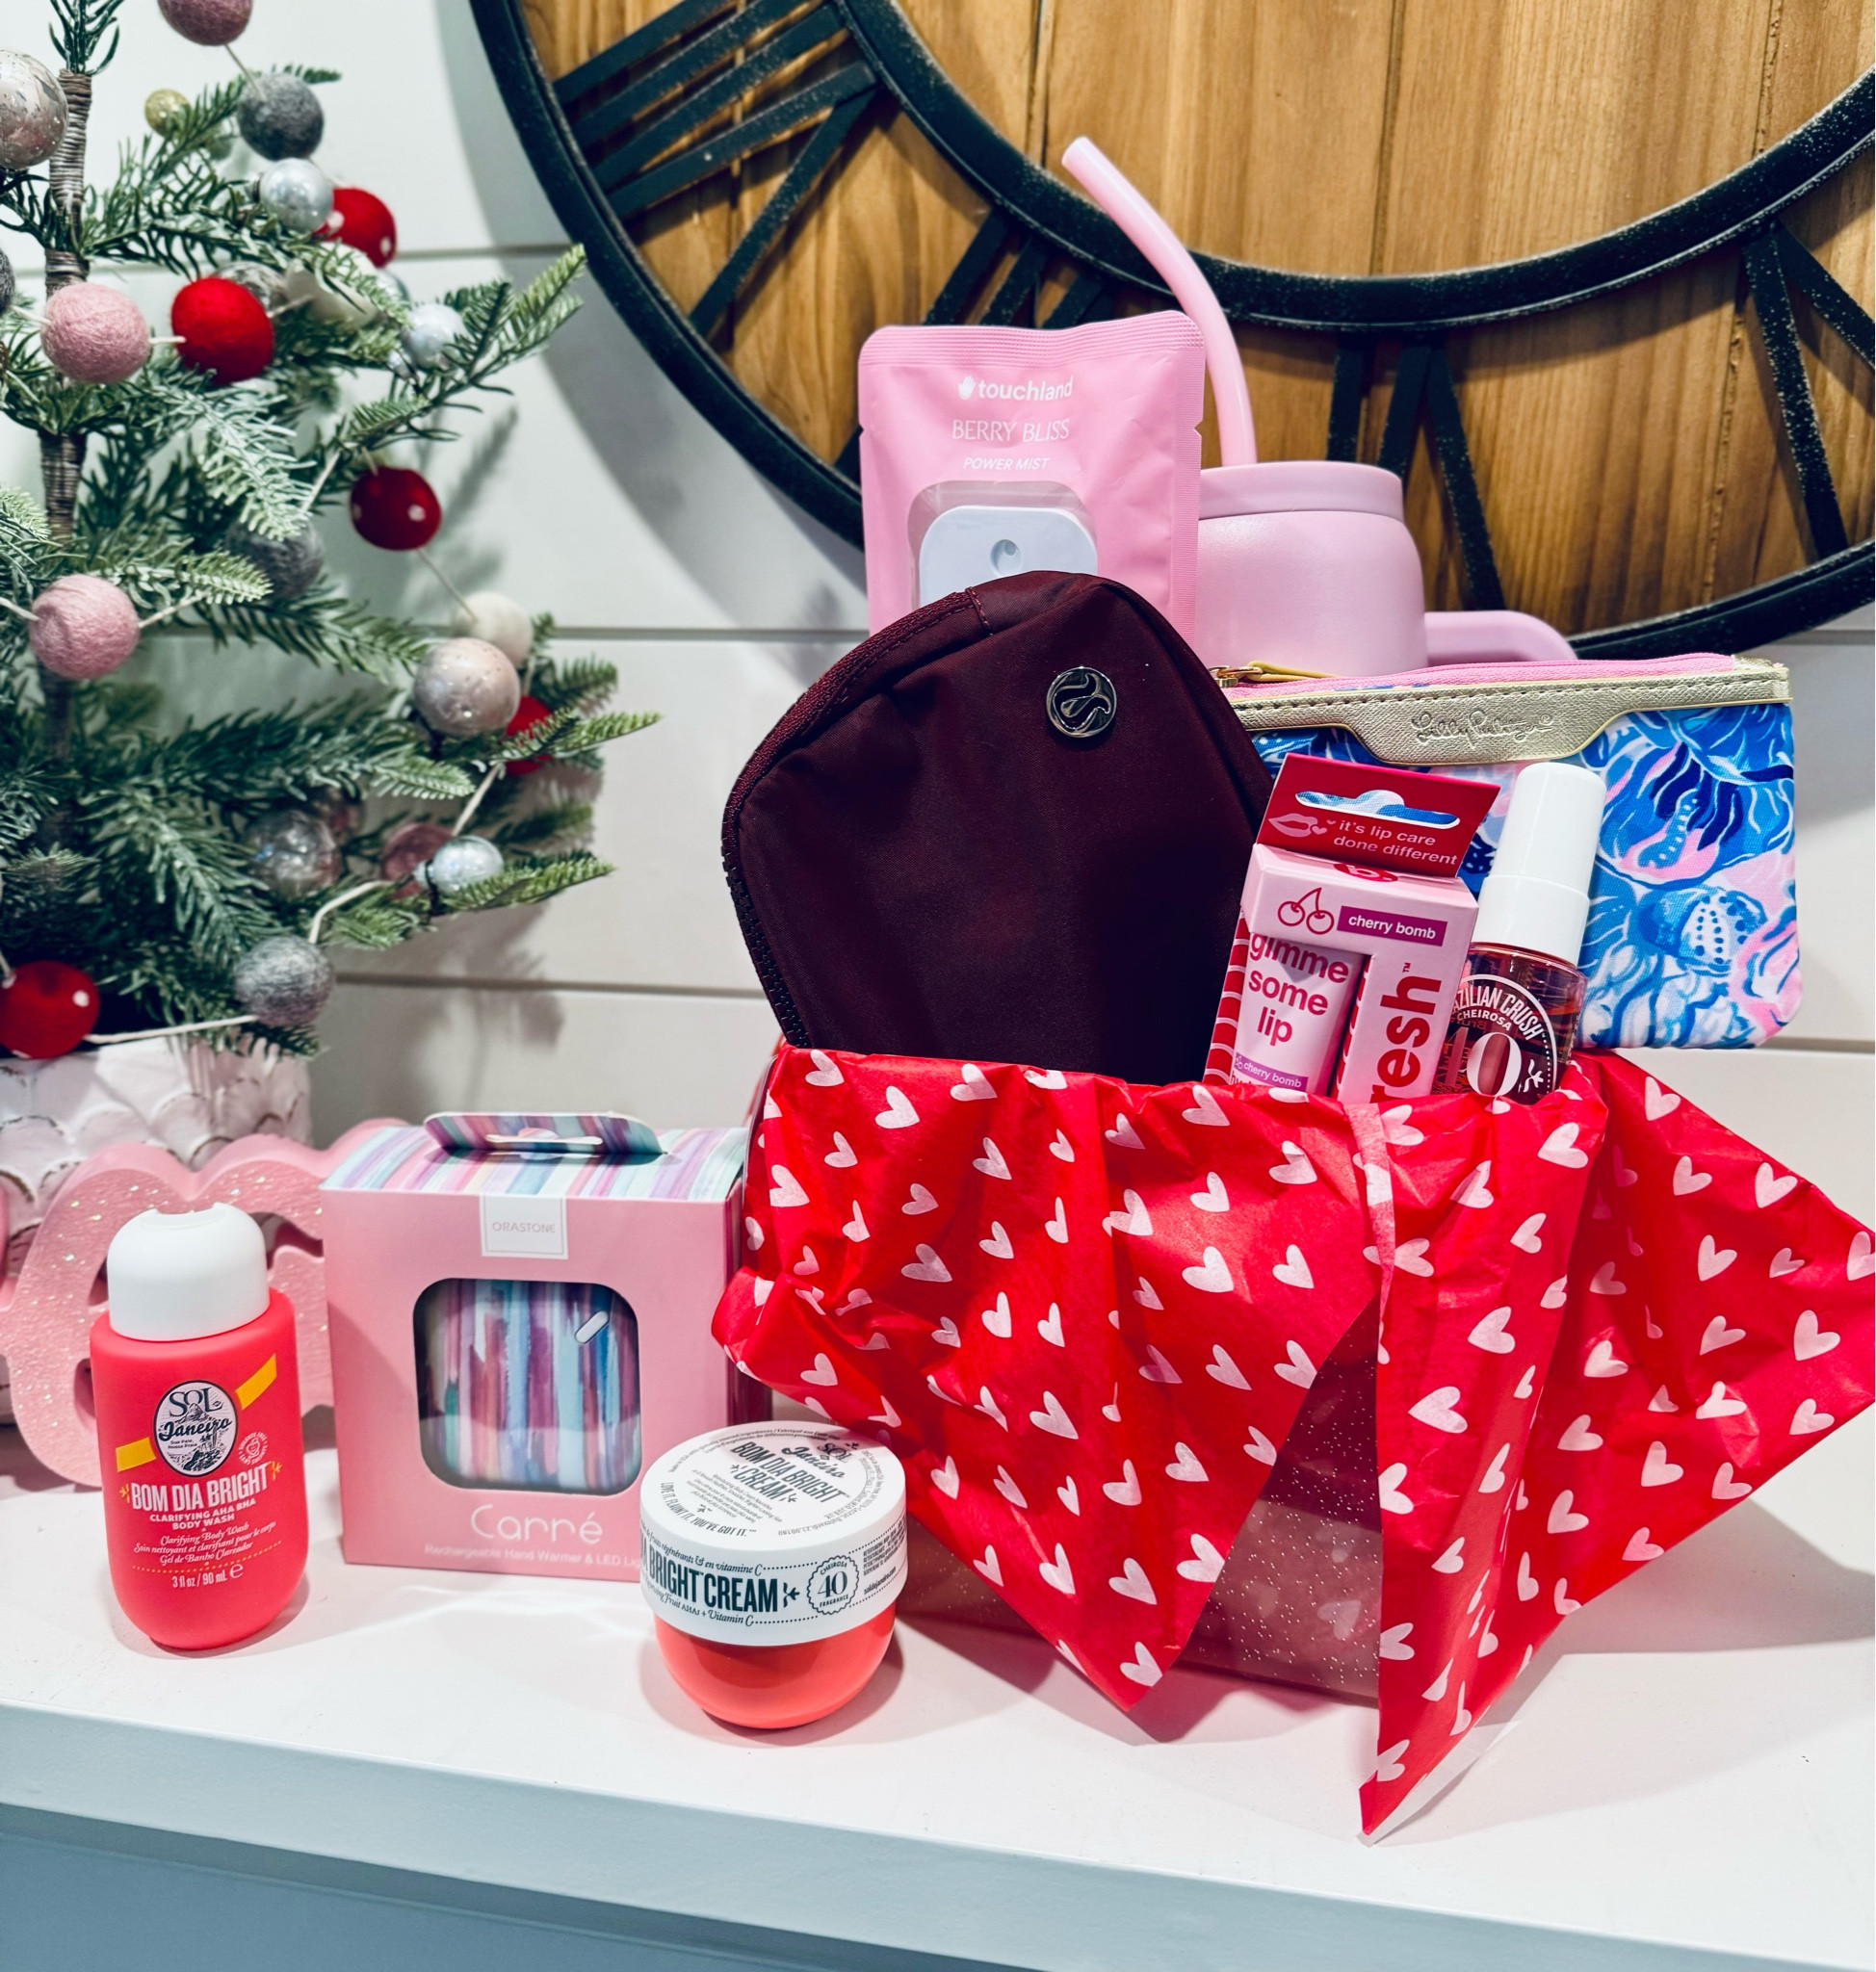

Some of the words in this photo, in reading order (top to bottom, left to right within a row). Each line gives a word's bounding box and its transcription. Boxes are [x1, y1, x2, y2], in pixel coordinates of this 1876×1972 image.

[978, 376, 1074, 401] touchland
[952, 420, 1016, 441] BERRY
[1022, 419, 1070, 442] BLISS
[964, 457, 1013, 471] POWER
[1015, 457, 1052, 470] MIST
[1339, 819, 1365, 834] it's
[1369, 825, 1393, 841] lip
[1396, 832, 1436, 846] care
[1334, 836, 1378, 852] done
[1383, 845, 1458, 866] different
[1348, 915, 1393, 935] cherry
[1396, 922, 1436, 940] bomb
[1249, 933, 1349, 983] gimme
[1248, 970, 1329, 1016] some
[1453, 985, 1502, 1014] AZILIAN
[1499, 994, 1544, 1041] CRUSH
[1457, 1009, 1512, 1031] CHEIROSA
[1257, 1006, 1292, 1047] lip
[1243, 1062, 1271, 1080] cherry
[1272, 1072, 1302, 1088] bomb
[492, 1222, 556, 1233] ORASTONE
[169, 1387, 223, 1417] SOL
[158, 1417, 233, 1442] Janeiro
[730, 1441, 769, 1465] BOM
[762, 1453, 796, 1476] DIA
[781, 1469, 847, 1502] BRIGHT
[781, 1446, 846, 1478] Janeiro
[131, 1482, 169, 1512] BOM
[171, 1482, 204, 1512] DIA
[206, 1462, 271, 1508] BRIGHT
[733, 1467, 794, 1500] CREAM
[149, 1510, 210, 1522] CLARIFYING
[213, 1505, 234, 1517] AHA
[236, 1497, 256, 1511] BHA
[172, 1520, 200, 1530] BODY
[203, 1514, 235, 1527] WASH
[161, 1535, 201, 1546] Clarifying
[201, 1529, 225, 1543] Body
[226, 1521, 249, 1535] Wash
[471, 1503, 603, 1544] Carré
[717, 1525, 737, 1535] GOT
[134, 1542, 150, 1553] Soin
[151, 1545, 188, 1557] nettoyant
[160, 1554, 173, 1566] Gel
[174, 1555, 184, 1564] de
[185, 1551, 214, 1563] Banho
[424, 1544, 502, 1560] Rechargeable
[504, 1548, 535, 1561] Hand
[536, 1550, 581, 1564] Warmer
[585, 1554, 593, 1565] &
[596, 1554, 621, 1567] LED
[695, 1555, 705, 1567] &
[716, 1562, 754, 1573] vitamine
[754, 1563, 763, 1576] C
[820, 1560, 847, 1575] CHEIROSA
[172, 1575, 178, 1588] 3
[179, 1574, 186, 1588] fl
[186, 1577, 195, 1588] oz
[202, 1571, 215, 1586] 90
[649, 1544, 701, 1603] BRIGHT
[704, 1573, 778, 1613] CREAM
[818, 1570, 847, 1598] 40
[820, 1594, 848, 1608] FRAGRANCE
[708, 1609, 744, 1624] Vitamin
[744, 1614, 754, 1626] C
